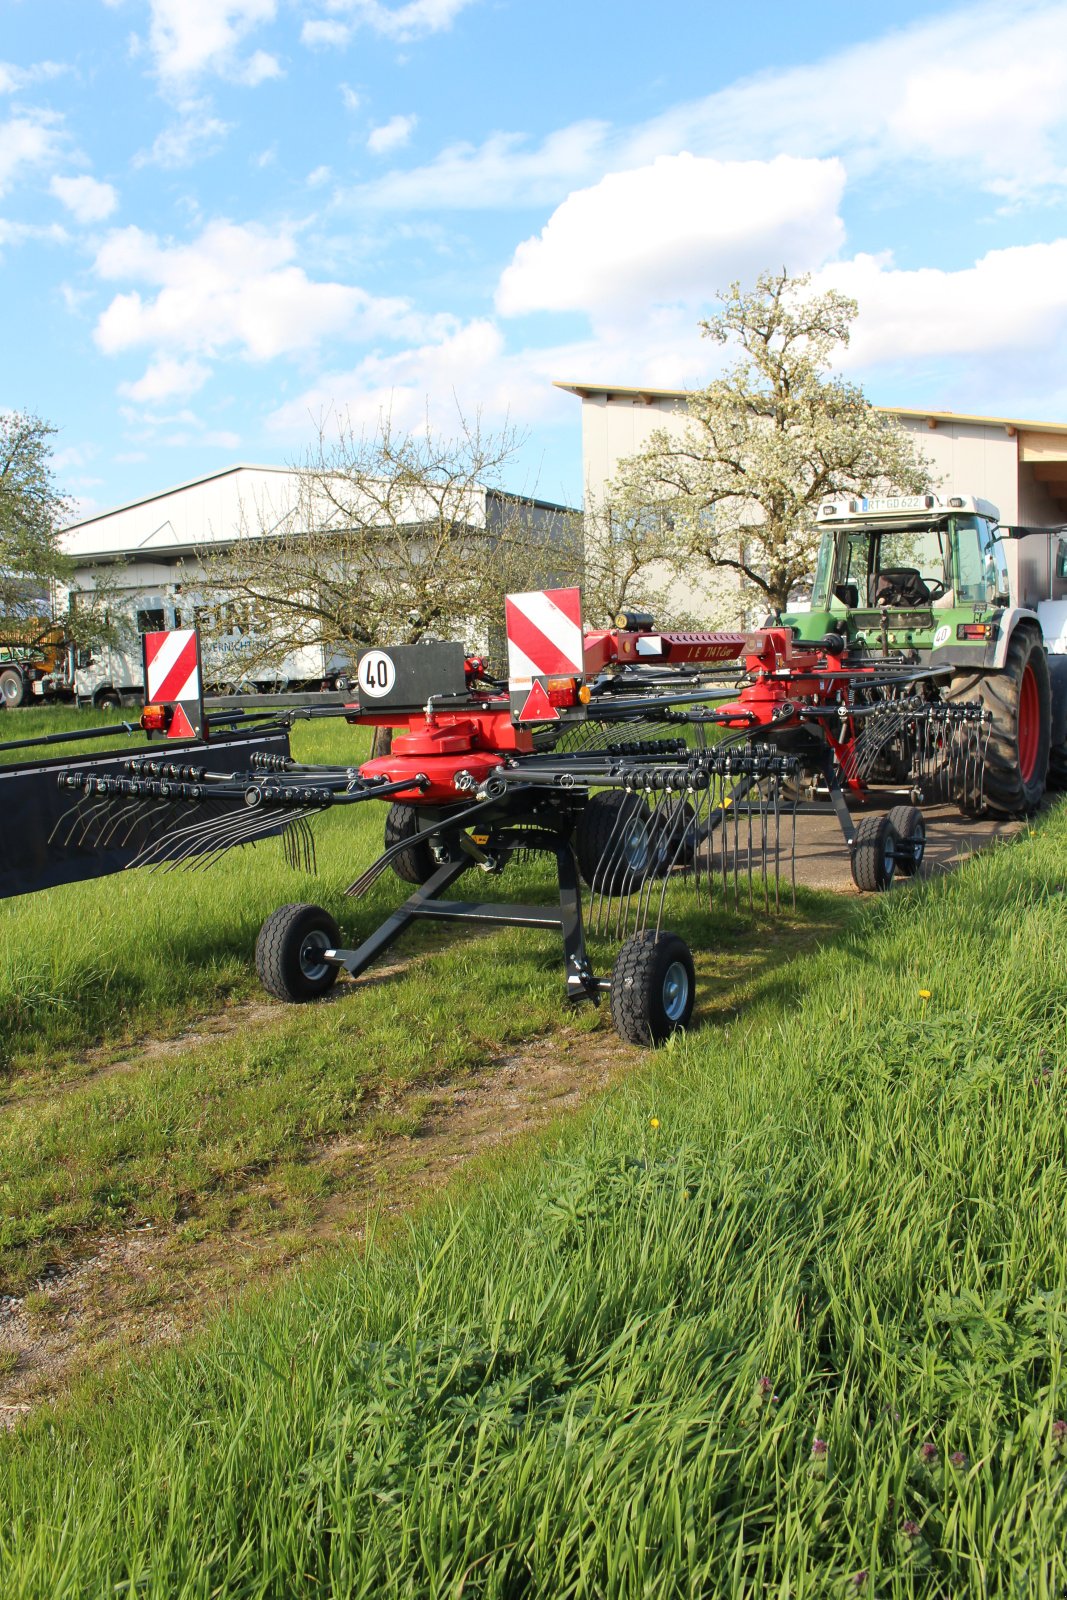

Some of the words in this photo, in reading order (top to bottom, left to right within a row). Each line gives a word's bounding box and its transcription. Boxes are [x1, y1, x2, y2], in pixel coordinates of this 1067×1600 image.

[901, 497, 919, 508] 622
[936, 628, 947, 642] 40
[366, 660, 388, 689] 40
